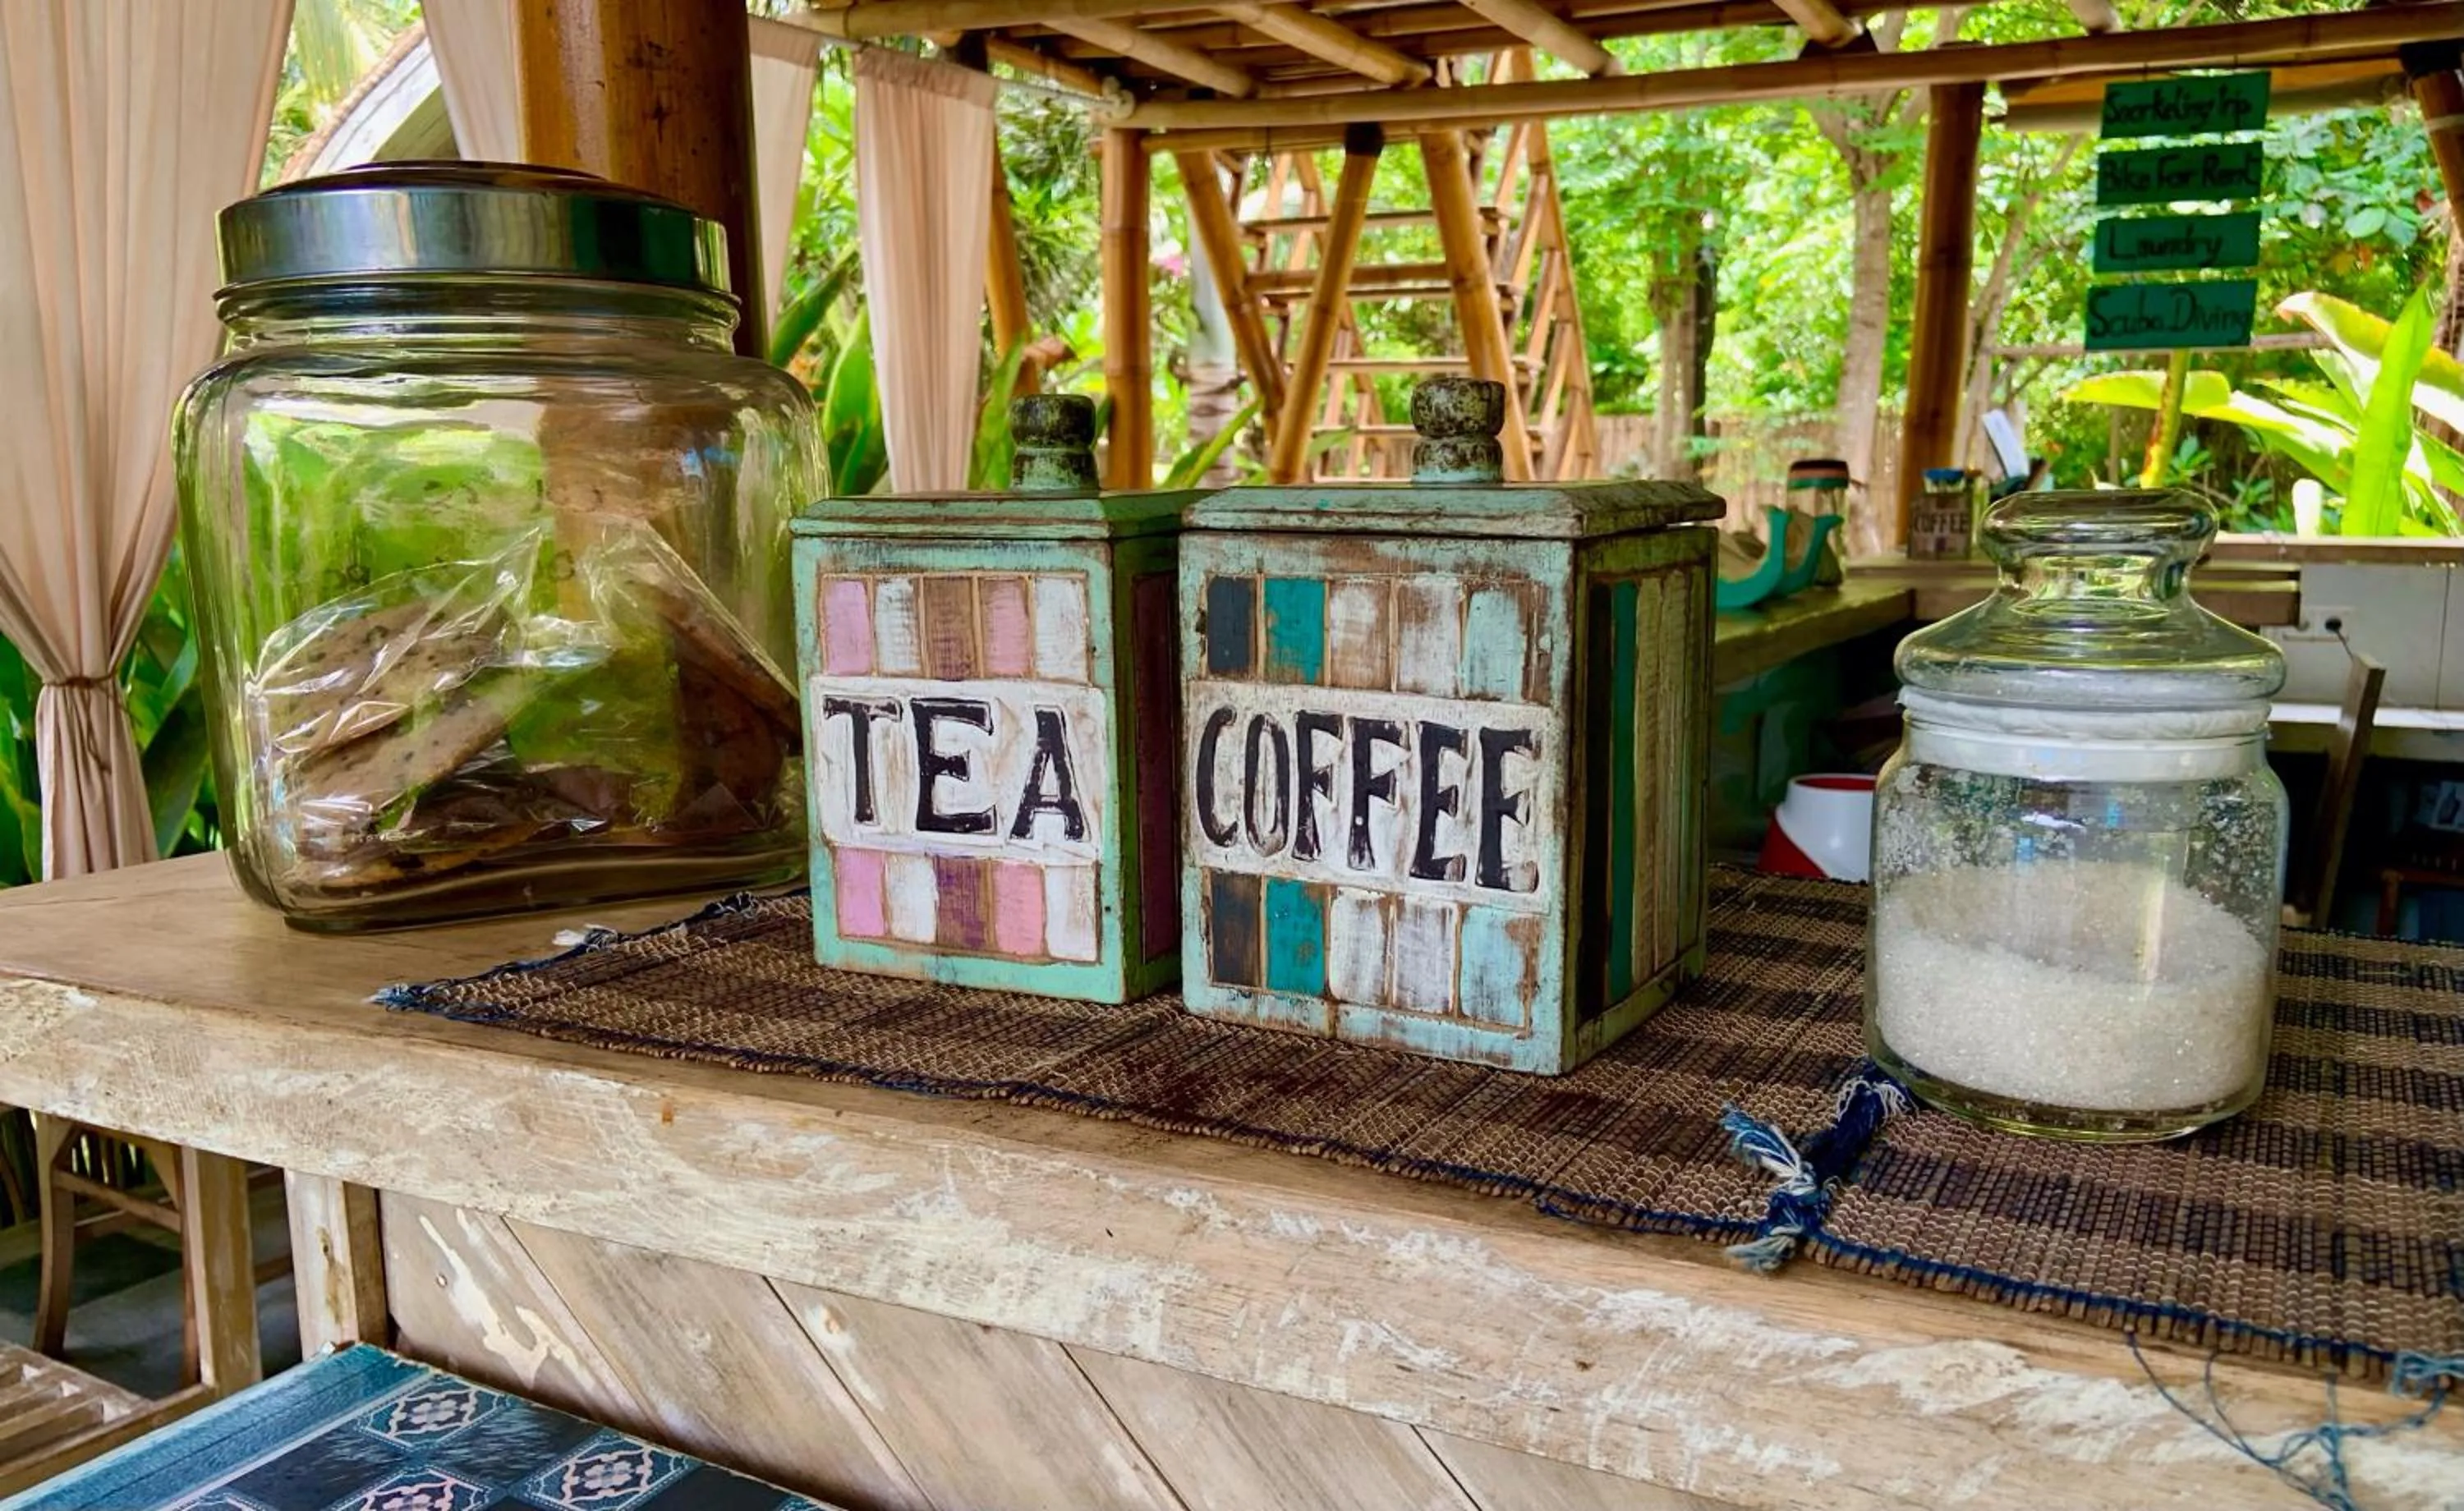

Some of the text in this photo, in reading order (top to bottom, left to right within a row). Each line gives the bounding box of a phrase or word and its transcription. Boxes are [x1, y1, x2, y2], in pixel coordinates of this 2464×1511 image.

[2158, 154, 2194, 189] For
[2203, 152, 2261, 189] Rent
[2108, 223, 2223, 268] Laundry
[2088, 287, 2164, 338] Scuba
[823, 695, 1091, 843] TEA
[1196, 705, 1542, 894] COFFEE
